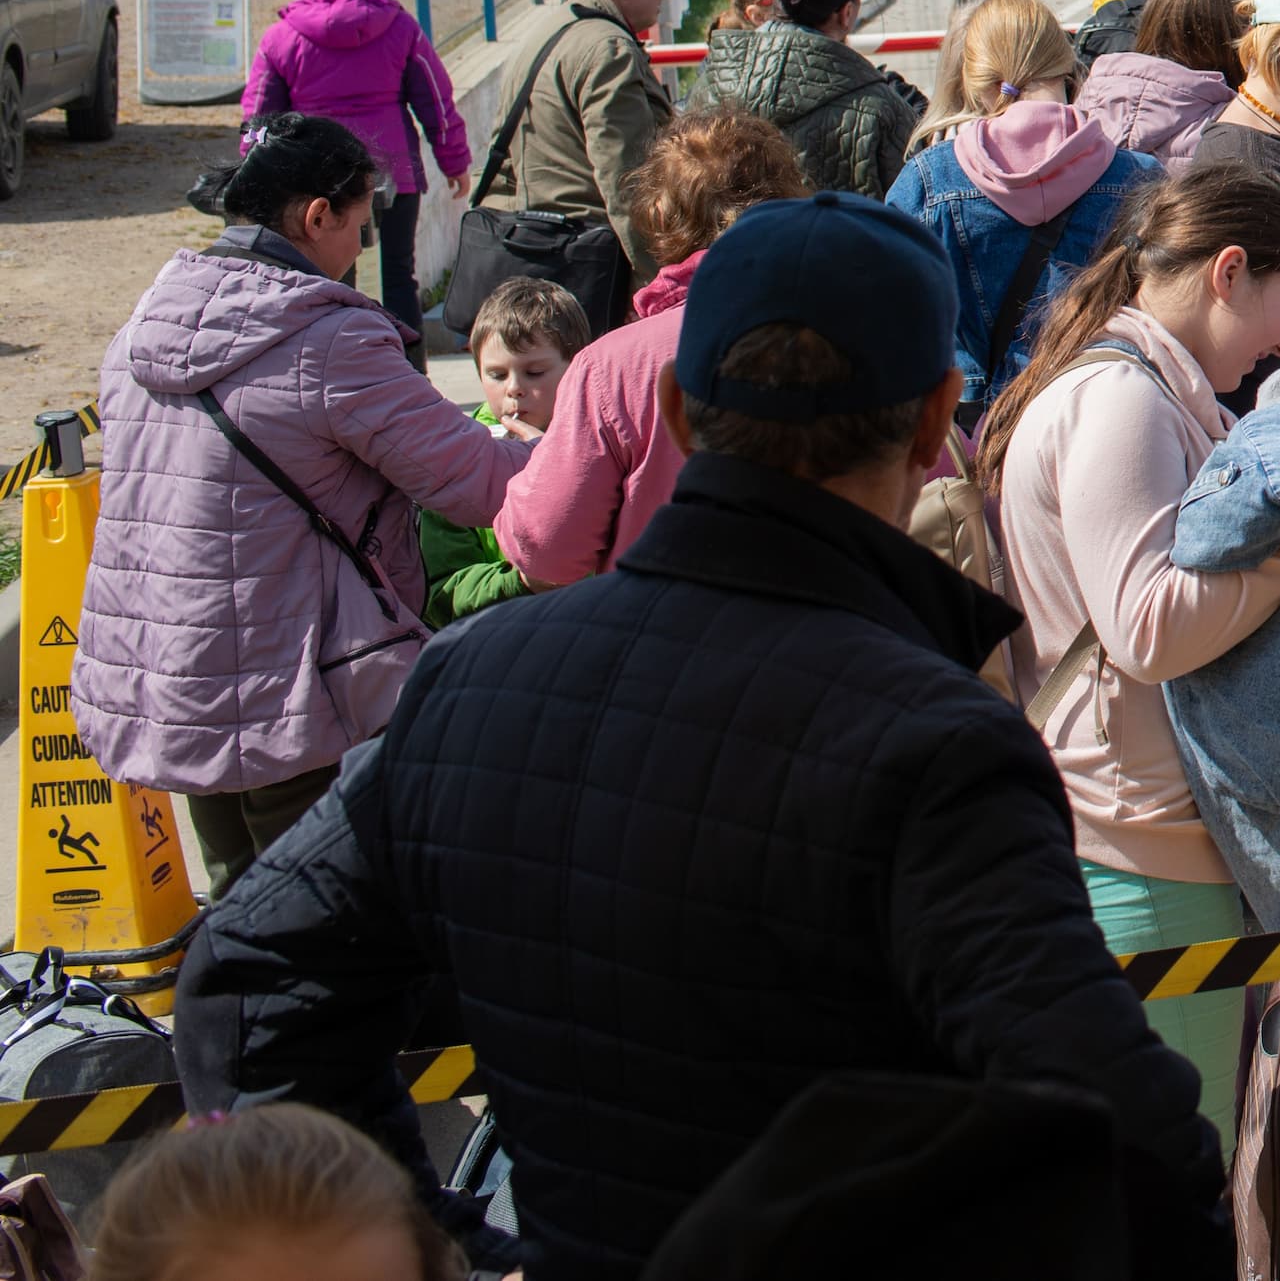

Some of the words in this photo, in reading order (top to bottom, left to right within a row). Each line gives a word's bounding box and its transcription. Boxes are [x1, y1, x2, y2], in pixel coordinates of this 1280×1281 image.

[31, 684, 72, 714] CAUT
[32, 734, 93, 763] CUIDAD
[31, 778, 112, 808] ATTENTION
